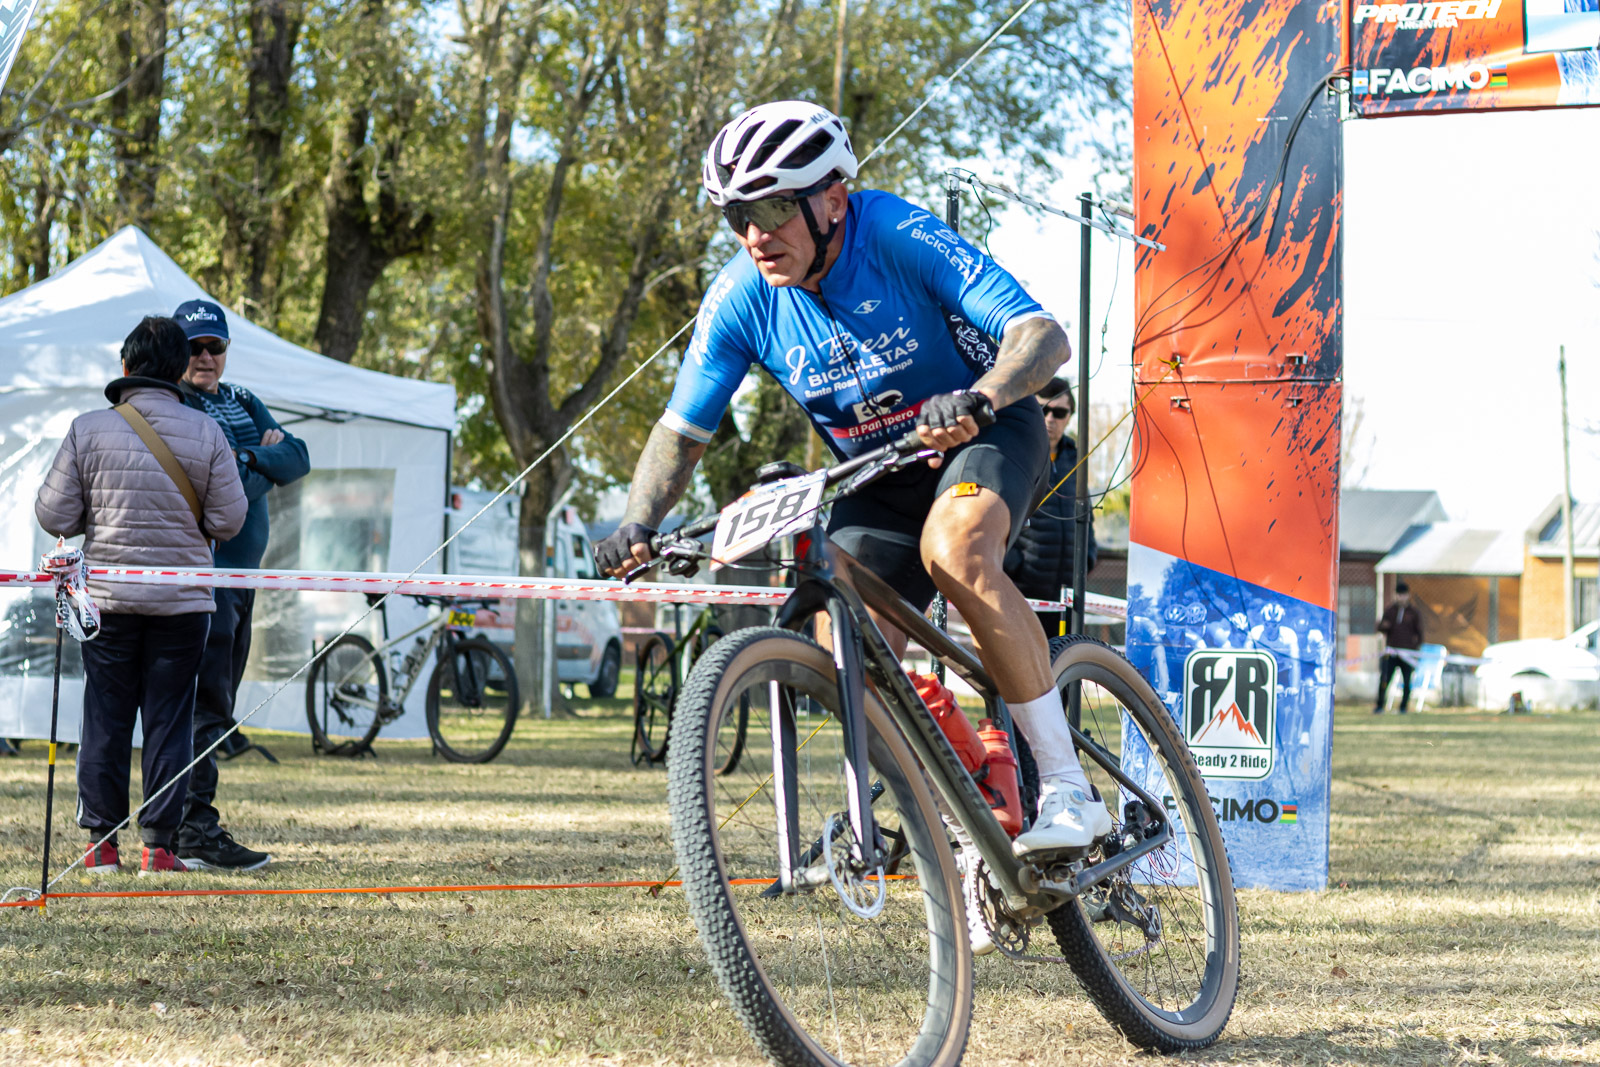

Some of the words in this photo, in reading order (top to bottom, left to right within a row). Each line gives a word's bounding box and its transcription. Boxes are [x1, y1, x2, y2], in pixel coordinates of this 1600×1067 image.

[1353, 0, 1501, 24] PROTECH
[1369, 64, 1489, 94] FACIMO
[818, 316, 910, 365] Besi
[804, 385, 832, 398] Santa
[834, 377, 859, 392] Rosa
[866, 370, 878, 380] La
[880, 357, 913, 376] Pampa
[807, 338, 919, 387] BICICLETAS
[848, 426, 859, 437] El
[861, 410, 914, 434] Pampero
[724, 488, 812, 548] 158
[1230, 754, 1237, 768] 2
[1240, 755, 1267, 769] Ride
